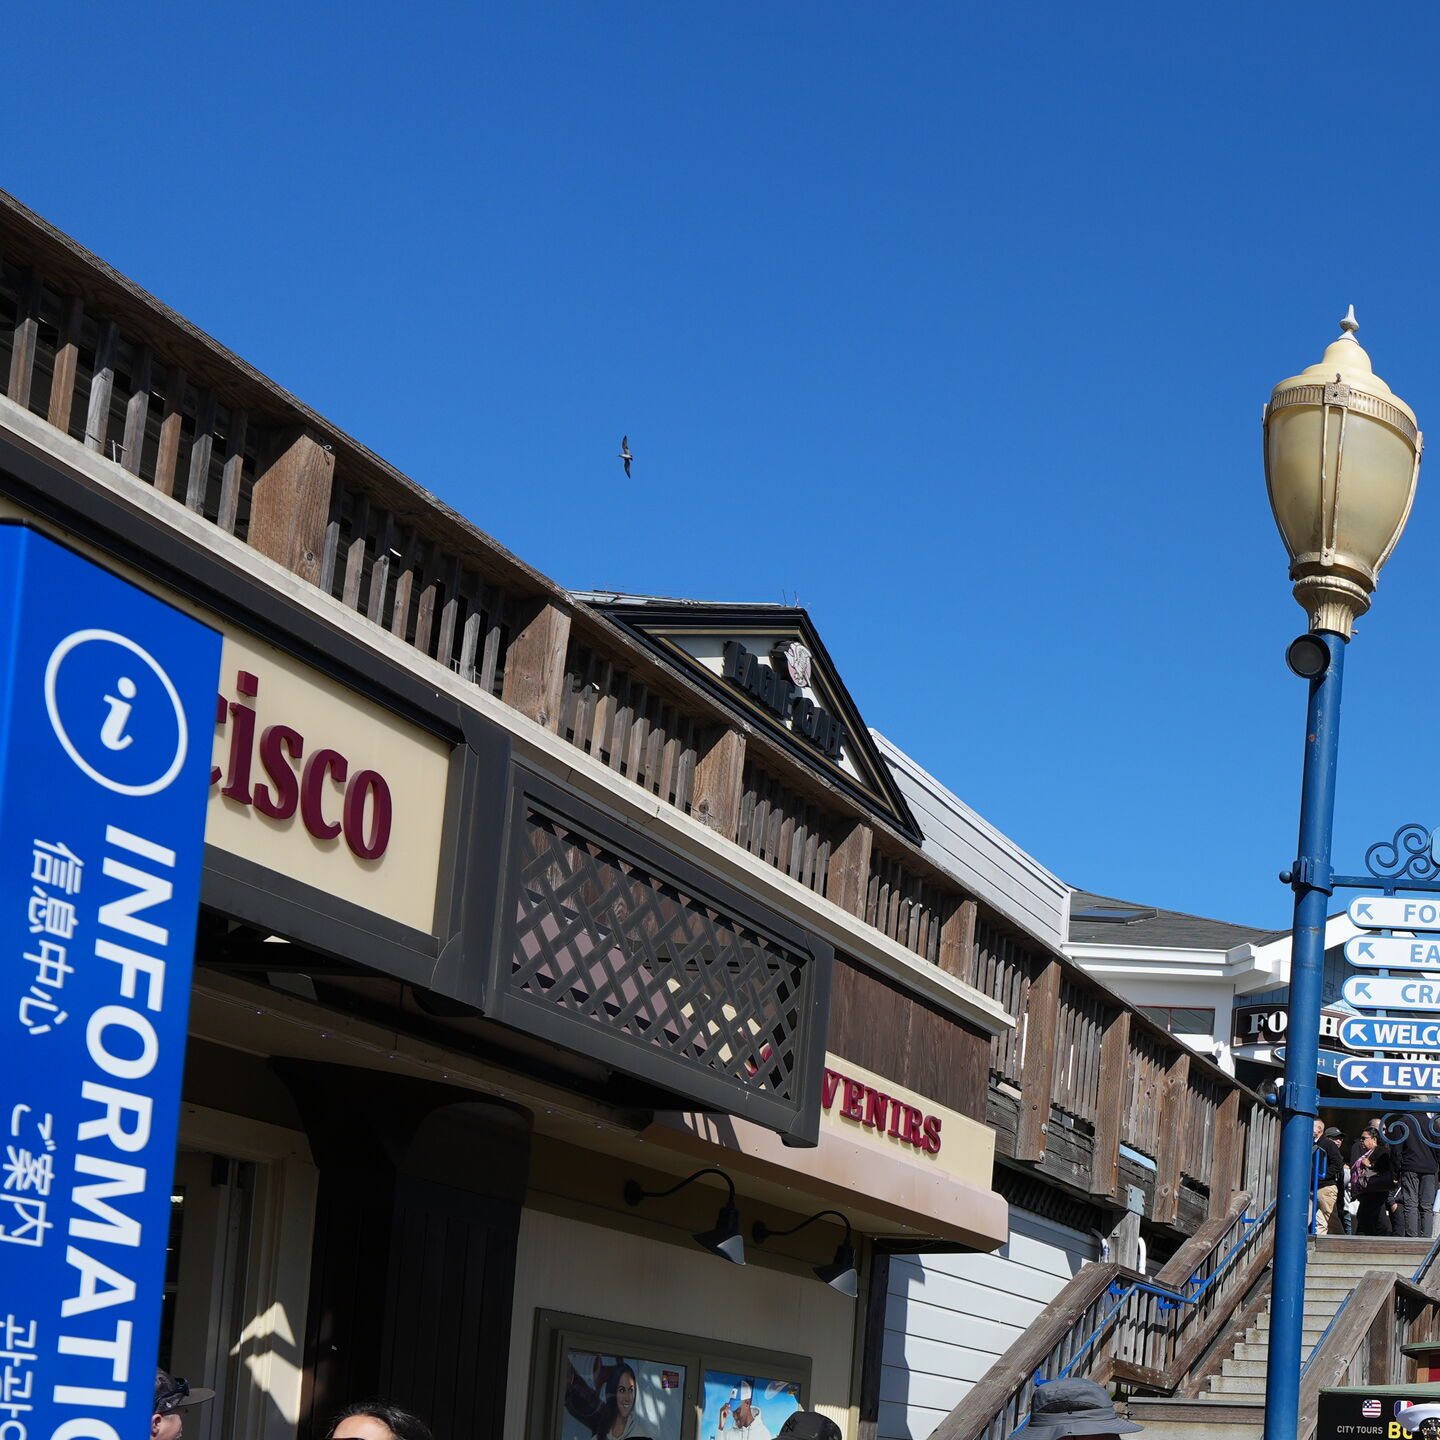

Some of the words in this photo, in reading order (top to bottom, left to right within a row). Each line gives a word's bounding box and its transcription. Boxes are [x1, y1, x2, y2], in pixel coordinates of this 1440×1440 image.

[210, 670, 392, 859] isco
[19, 838, 85, 1035] 信息中心
[1337, 1425, 1354, 1434] CITY
[1356, 1425, 1383, 1434] TOURS
